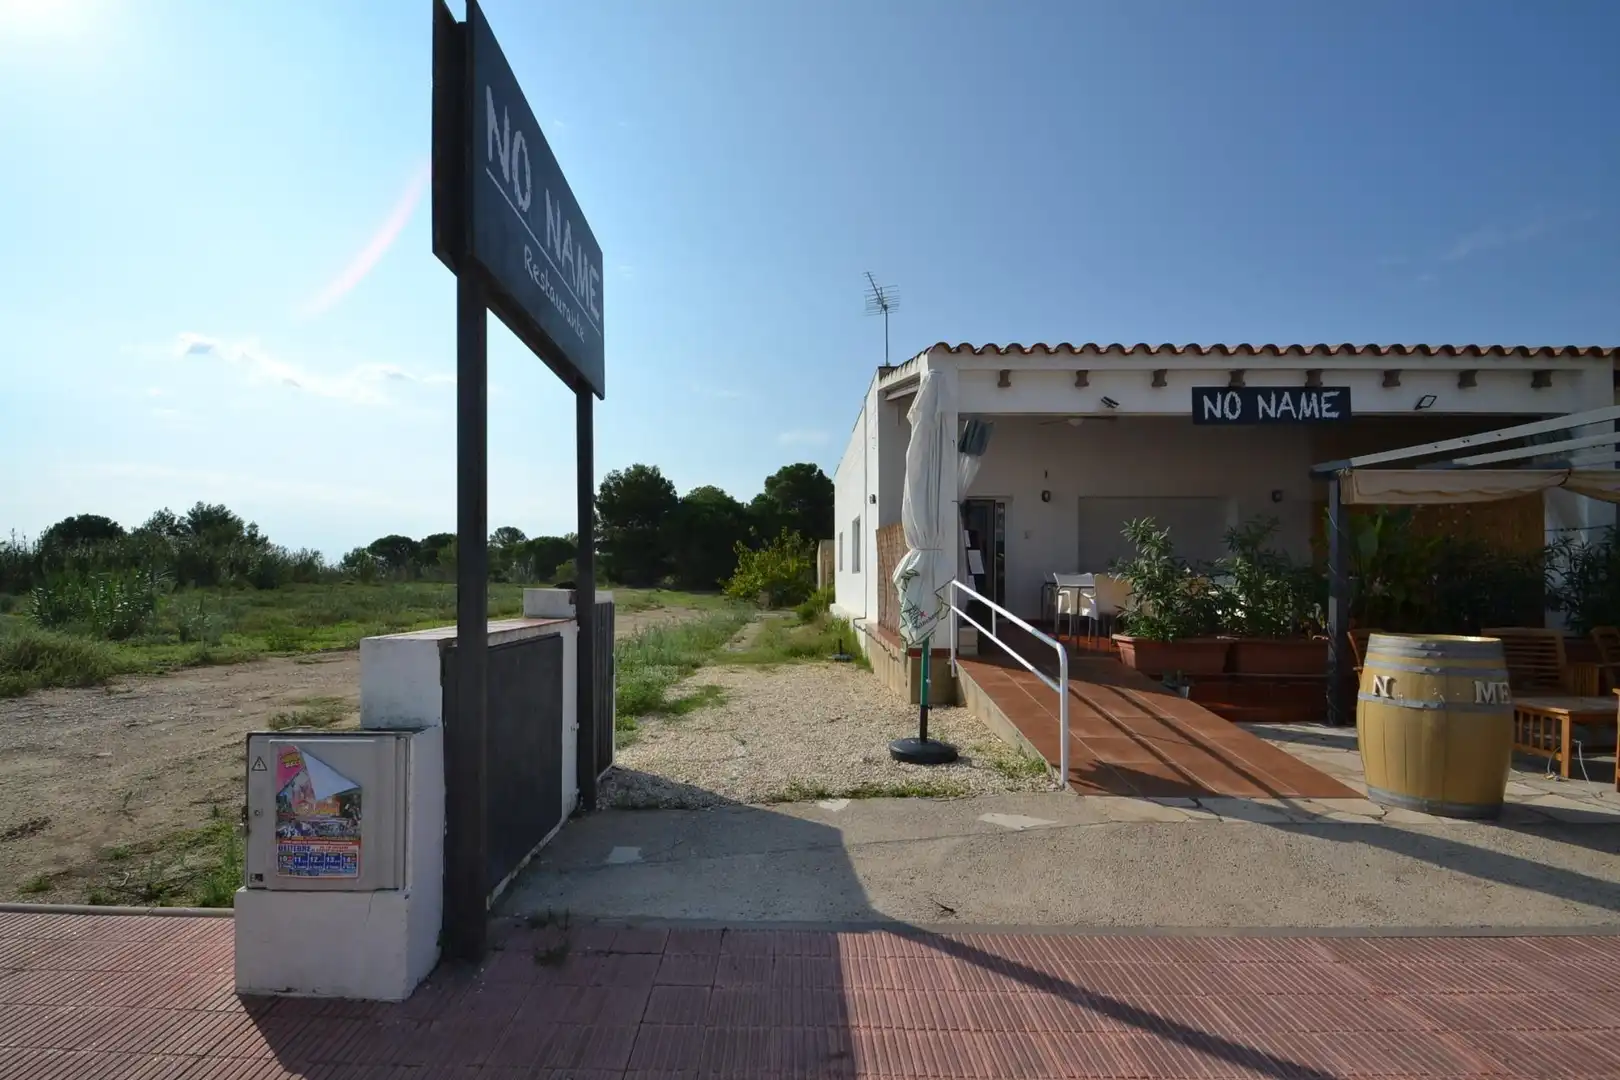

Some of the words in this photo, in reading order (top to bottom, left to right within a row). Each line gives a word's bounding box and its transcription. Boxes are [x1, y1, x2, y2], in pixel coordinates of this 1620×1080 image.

[485, 84, 532, 213] NO
[545, 188, 600, 321] NAME
[1202, 390, 1242, 421] NO
[1256, 390, 1341, 421] NAME
